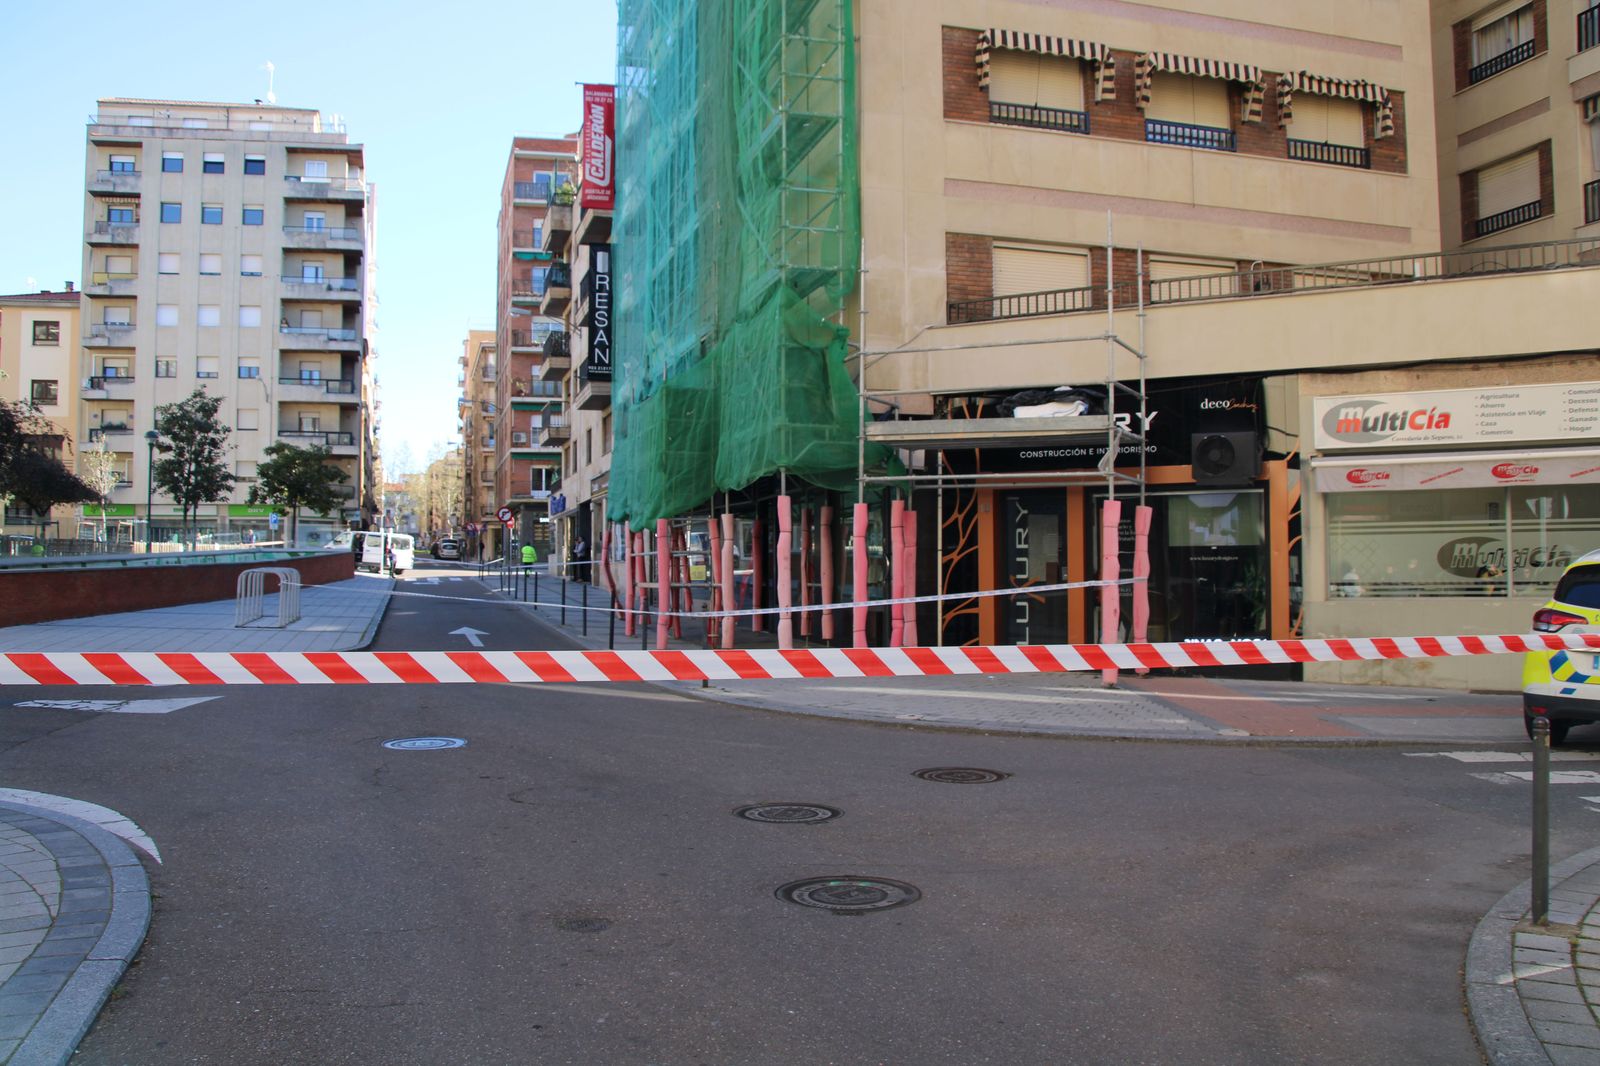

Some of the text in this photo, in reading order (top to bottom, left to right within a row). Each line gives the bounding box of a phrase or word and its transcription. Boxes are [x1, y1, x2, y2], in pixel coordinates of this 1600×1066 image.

[589, 103, 604, 178] CALDERÓN
[1480, 393, 1520, 401] Agricultura
[1527, 409, 1547, 417] Viaje
[1020, 448, 1087, 458] CONSTRUCCIÓN
